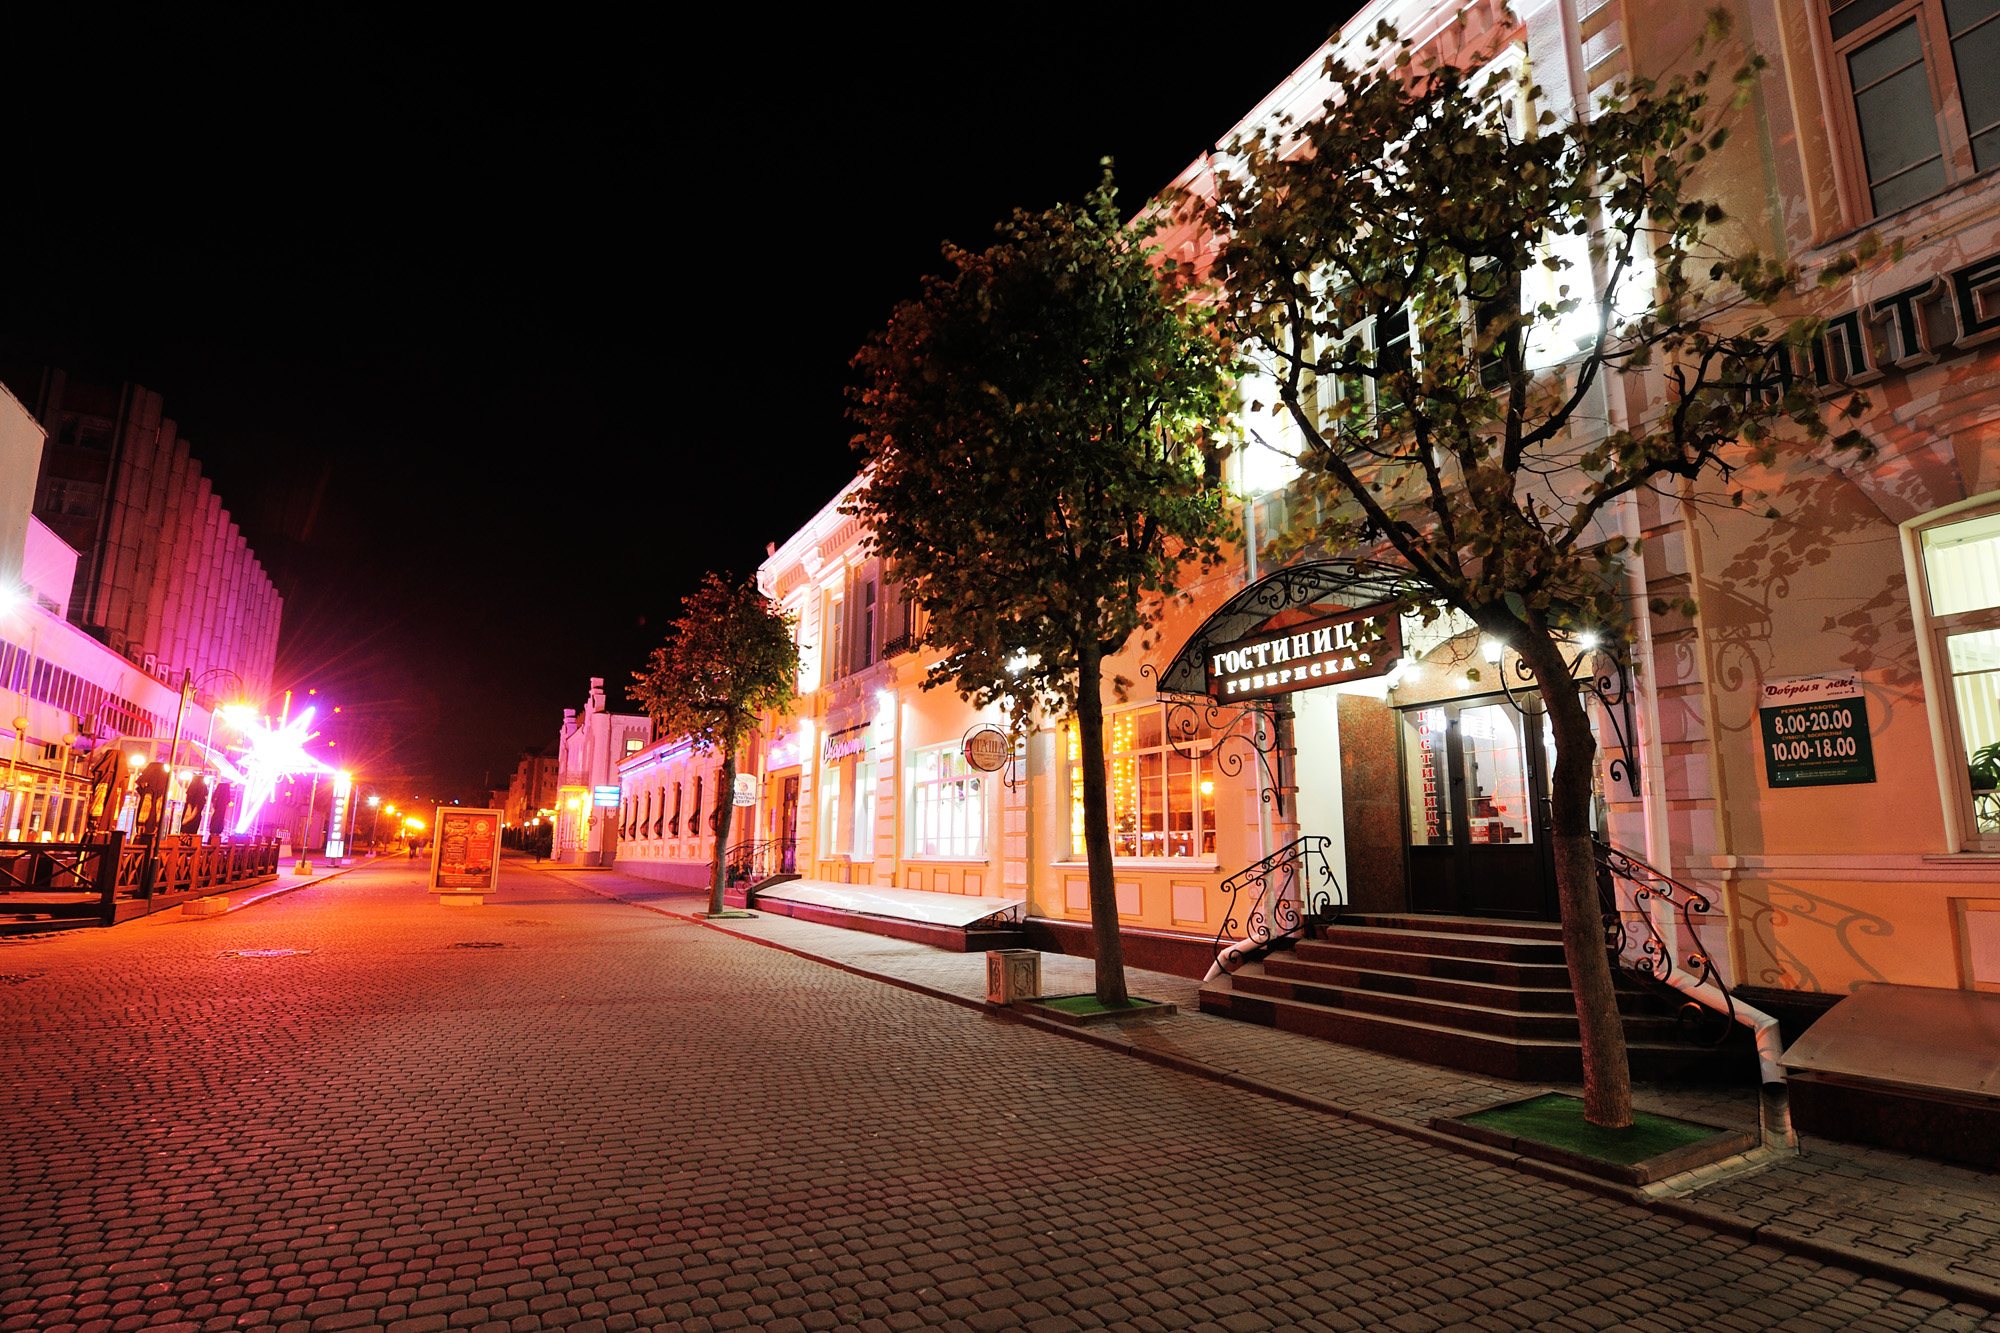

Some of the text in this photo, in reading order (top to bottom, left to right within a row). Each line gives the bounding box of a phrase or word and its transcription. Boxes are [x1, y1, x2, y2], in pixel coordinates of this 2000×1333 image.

[1774, 709, 1852, 735] 8.00-20.00
[1771, 736, 1857, 761] 10.00-18.00
[1417, 711, 1440, 837] ГОСТИНИЦА
